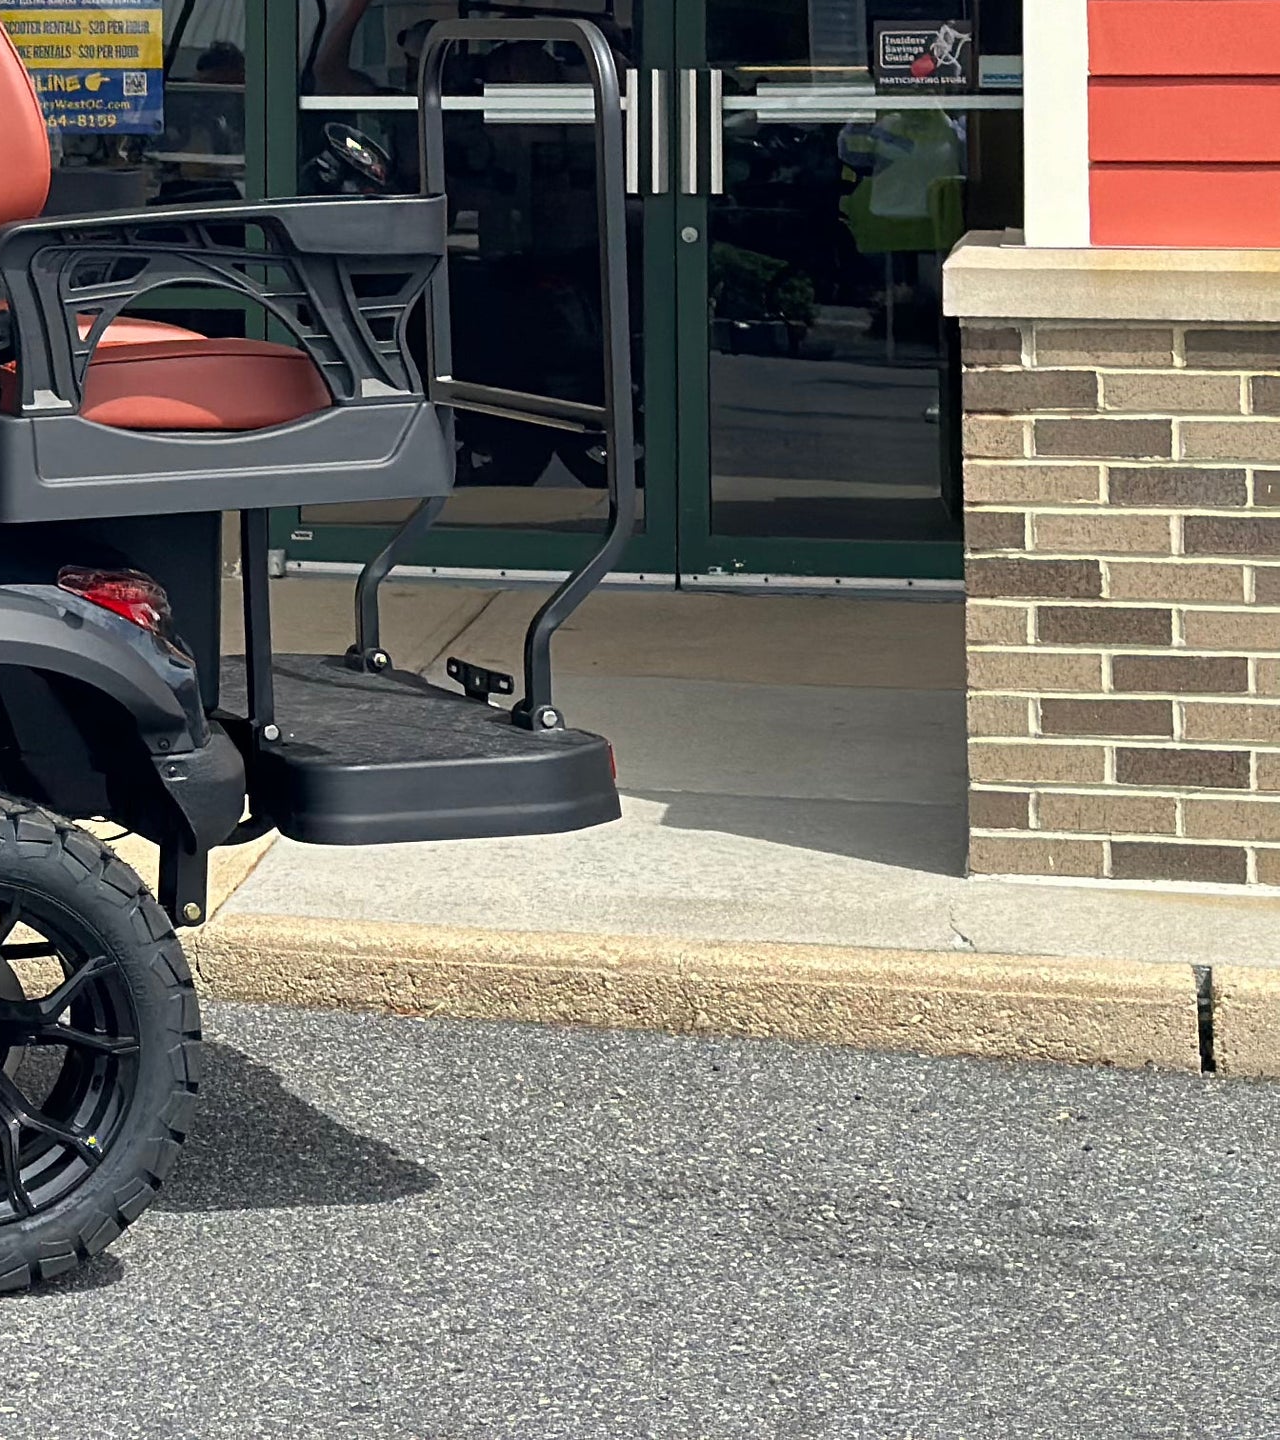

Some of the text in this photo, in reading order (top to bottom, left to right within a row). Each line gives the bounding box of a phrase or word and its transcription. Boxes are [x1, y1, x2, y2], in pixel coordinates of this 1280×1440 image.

[43, 20, 81, 35] RENTALS
[107, 20, 124, 35] PER
[34, 45, 72, 59] RENTALS
[97, 45, 114, 59] PER
